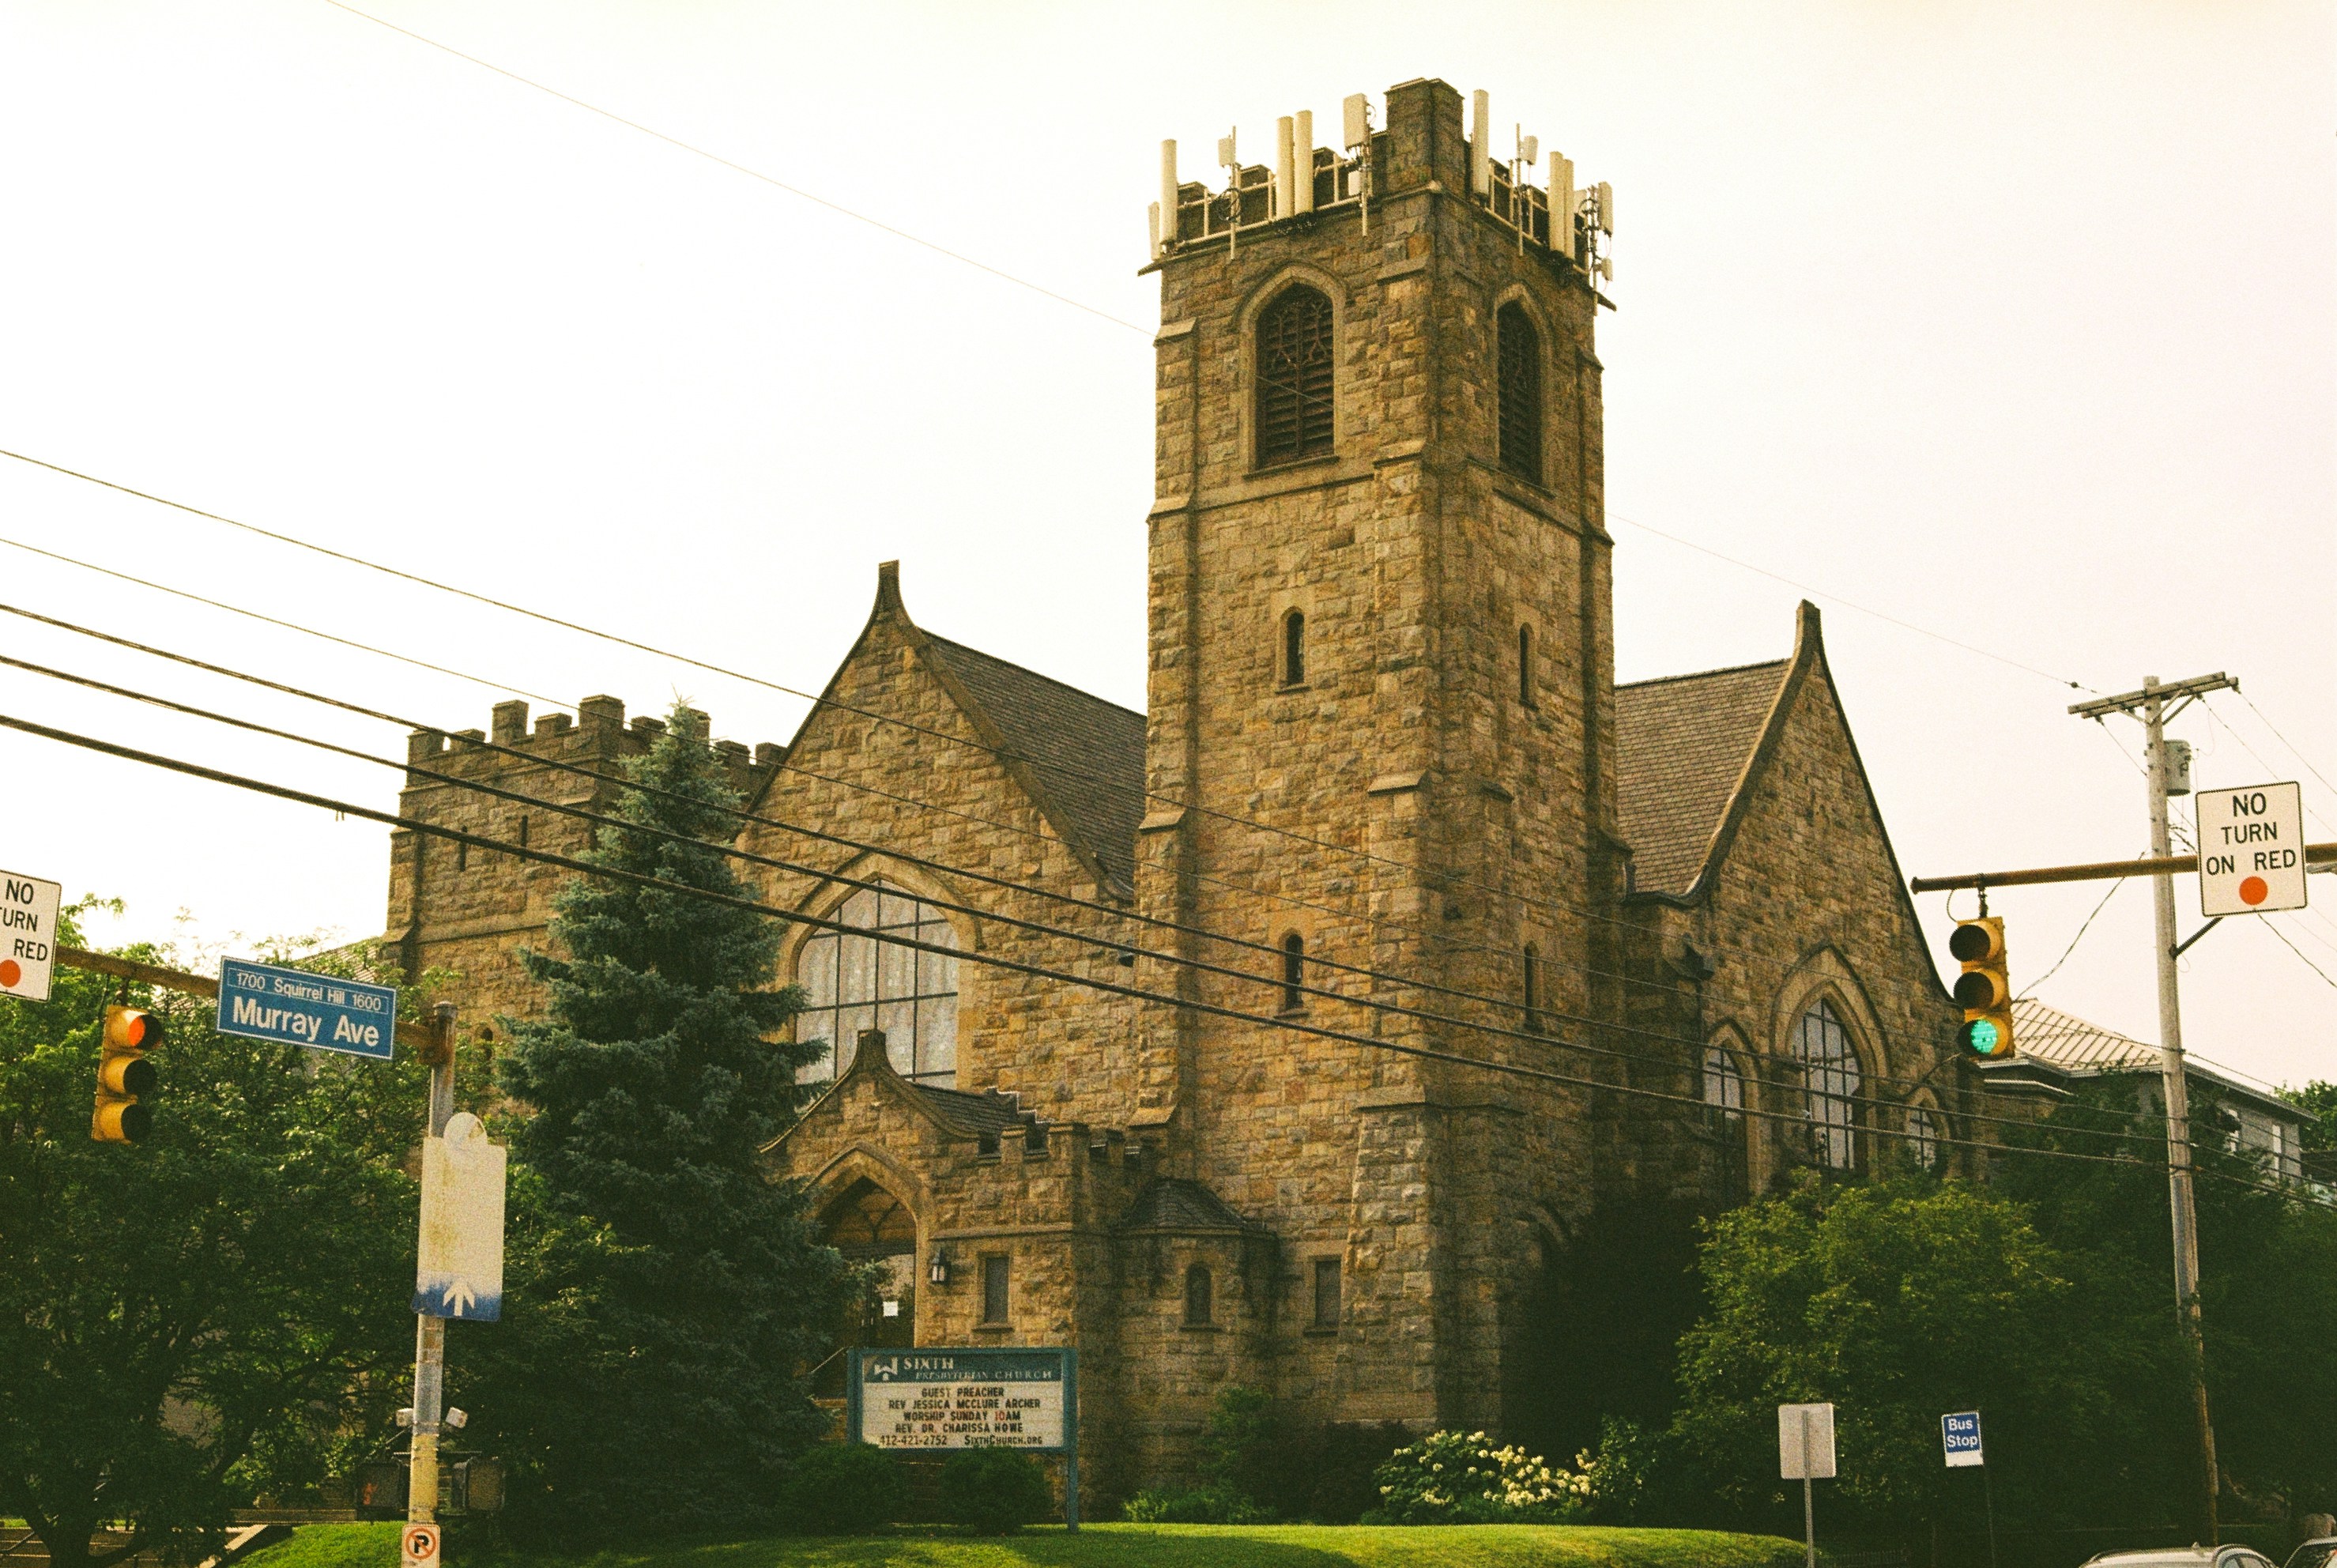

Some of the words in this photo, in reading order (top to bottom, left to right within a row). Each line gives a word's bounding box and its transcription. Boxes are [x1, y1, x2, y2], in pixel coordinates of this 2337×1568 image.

[2233, 792, 2267, 817] NO
[2221, 821, 2278, 845] TURN
[2206, 855, 2235, 876] ON
[2254, 849, 2297, 871] RED
[6, 879, 34, 905] NO
[13, 938, 48, 962] RED
[237, 971, 266, 990] 1700
[274, 977, 322, 1001] Squirrel
[327, 986, 345, 1004] Hill
[352, 993, 381, 1012] 1600
[232, 996, 322, 1042] Murray
[333, 1014, 379, 1047] Ave
[903, 1357, 954, 1370] SIXTH
[995, 1370, 1052, 1379] CHURCH
[922, 1388, 951, 1398] GUEST
[956, 1387, 1005, 1397] PREACHER
[888, 1400, 907, 1409] REV
[913, 1400, 950, 1409] JESSICA
[956, 1399, 1000, 1408] MCCLURE
[1005, 1398, 1041, 1408] ARCHER
[903, 1411, 945, 1421] WORSHIP
[950, 1411, 987, 1421] SUNDAY
[994, 1411, 1020, 1421] 10AM
[943, 1423, 990, 1433] CHARISSA
[994, 1423, 1023, 1433] HOWE
[1948, 1418, 1973, 1431] Bus
[880, 1434, 948, 1446] 412-421-2752
[1947, 1434, 1978, 1448] Stop
